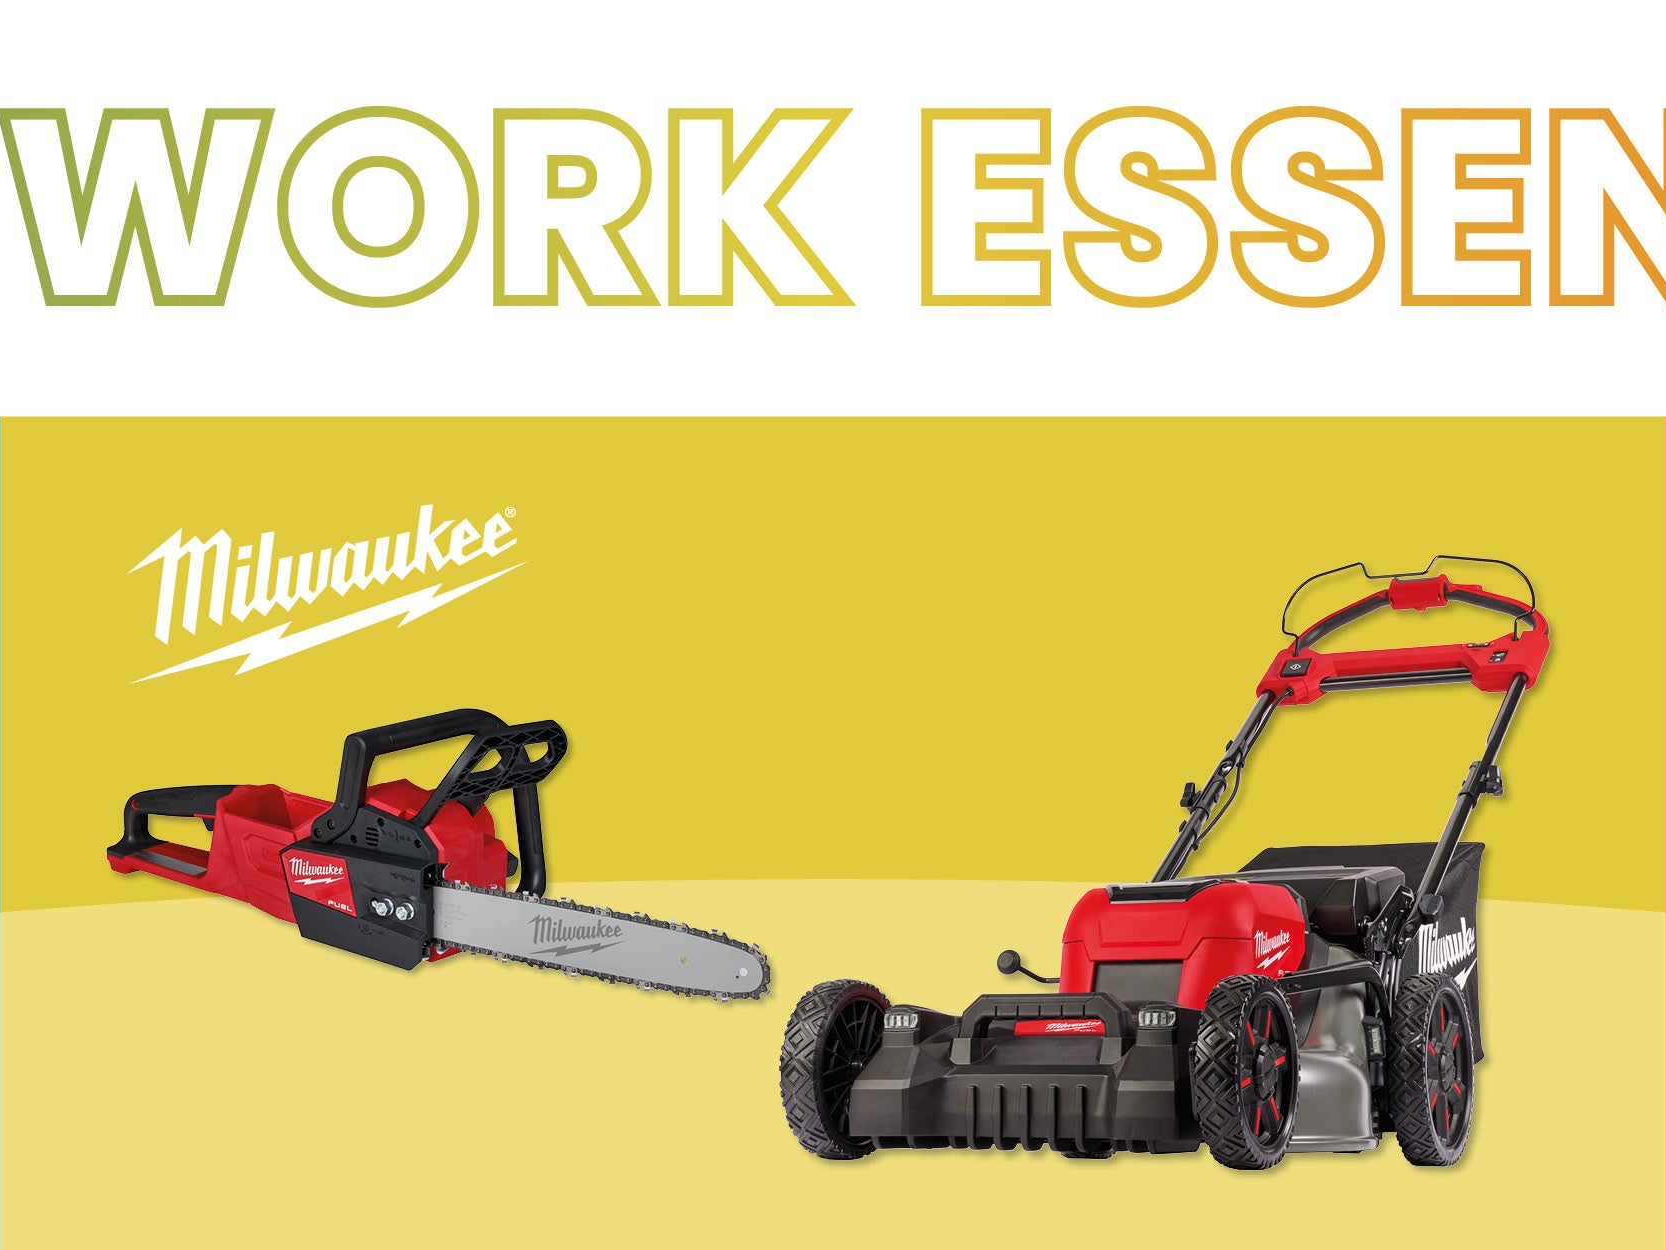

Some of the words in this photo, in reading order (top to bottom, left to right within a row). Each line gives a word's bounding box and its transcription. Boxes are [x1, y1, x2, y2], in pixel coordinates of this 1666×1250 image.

[289, 856, 344, 876] Milwaukee
[327, 899, 353, 912] FUEL
[527, 914, 623, 945] Milwaukee
